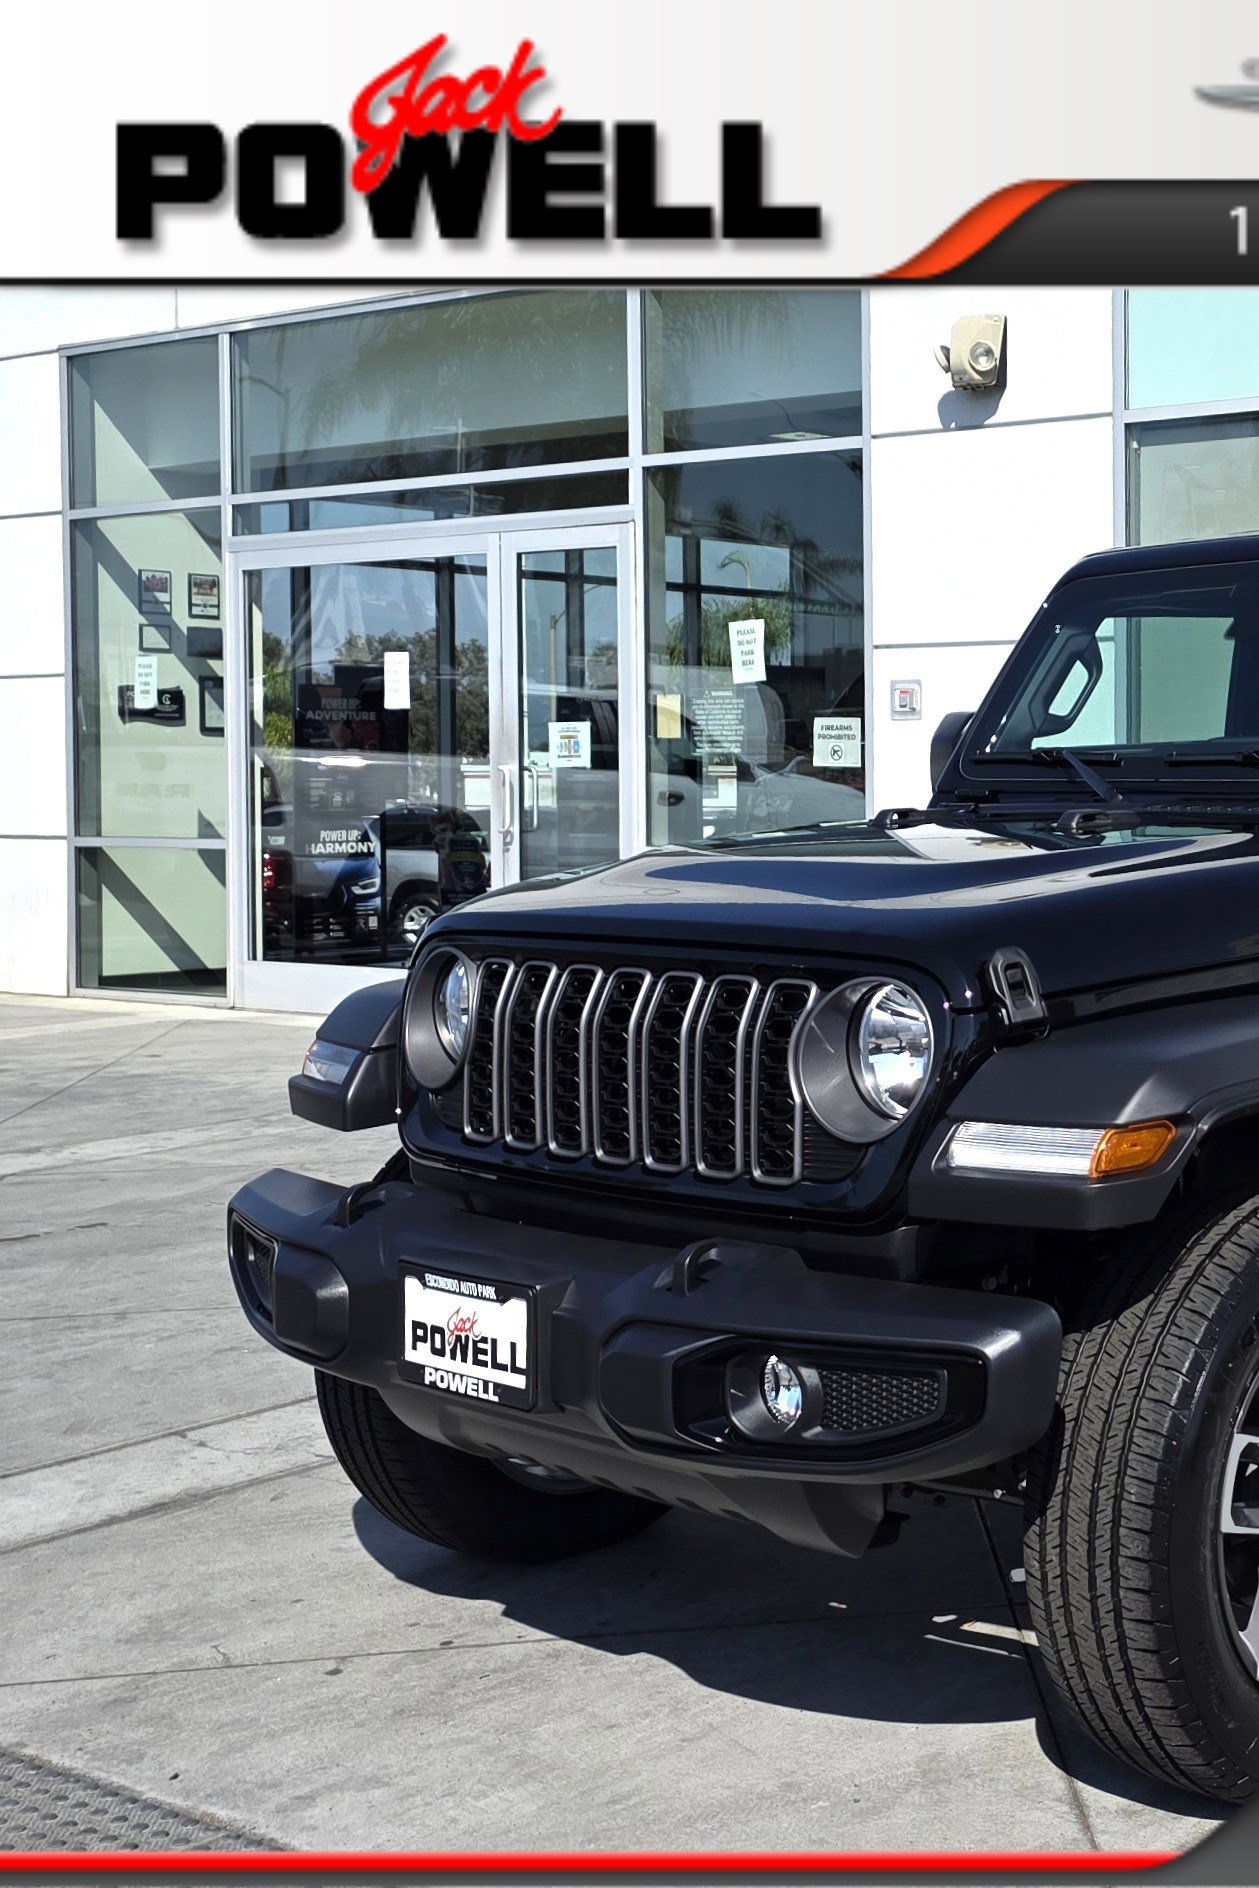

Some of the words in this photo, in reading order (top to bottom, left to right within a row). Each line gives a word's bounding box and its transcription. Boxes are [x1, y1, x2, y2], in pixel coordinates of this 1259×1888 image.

[305, 710, 377, 721] ADVENTURE
[817, 733, 857, 741] PROHIBITED
[320, 829, 347, 842] POWER
[348, 829, 362, 841] UP:
[305, 842, 377, 855] HARMONY
[460, 1280, 477, 1296] AUTO
[478, 1283, 497, 1300] PARK
[447, 1306, 483, 1348] Jack
[411, 1319, 526, 1376] POWELL
[424, 1366, 499, 1403] POWELL
